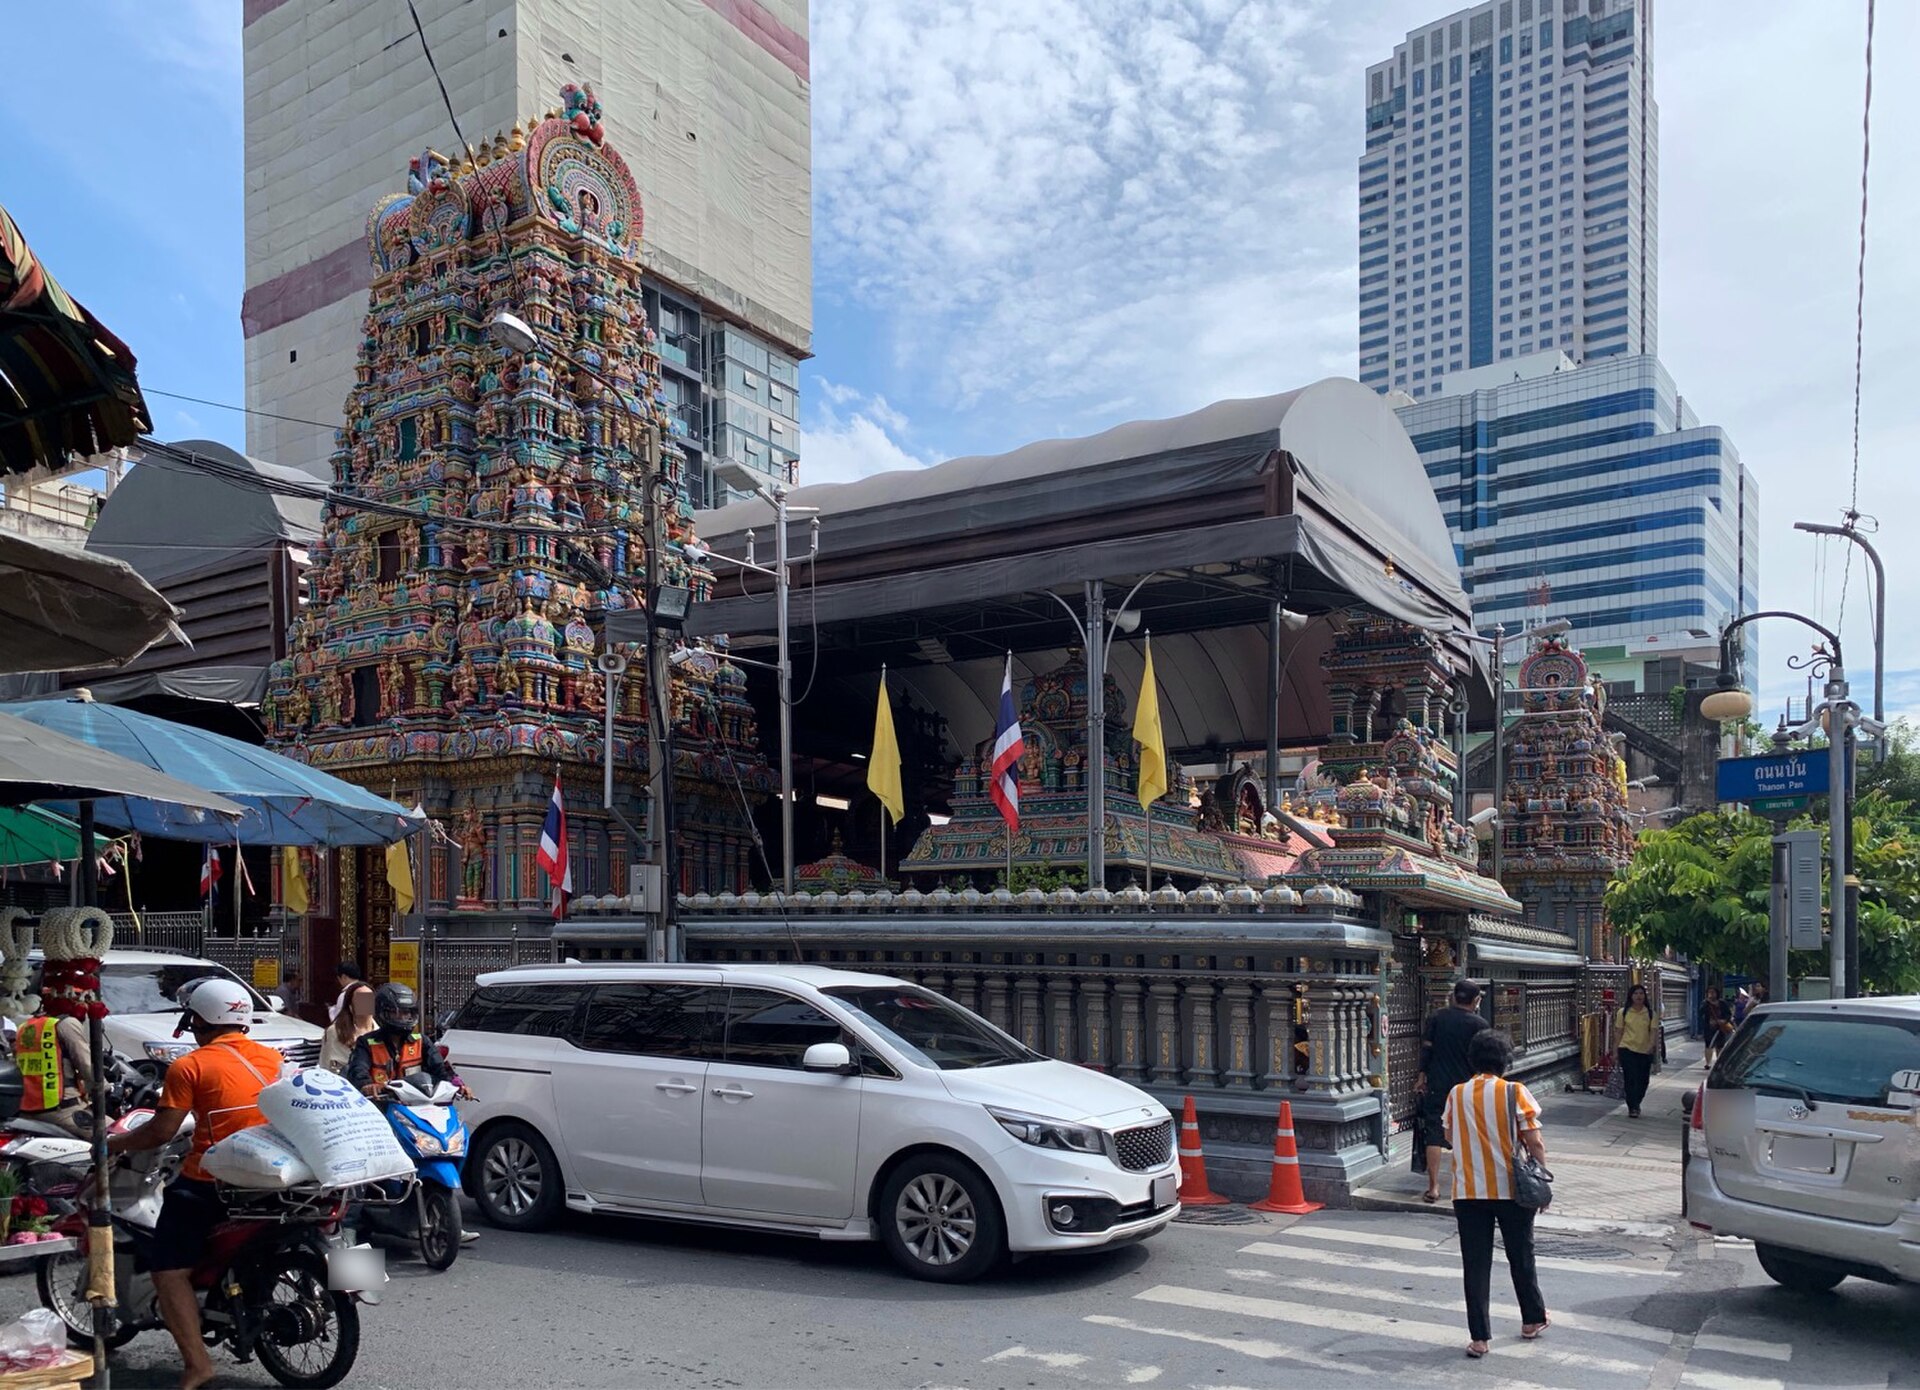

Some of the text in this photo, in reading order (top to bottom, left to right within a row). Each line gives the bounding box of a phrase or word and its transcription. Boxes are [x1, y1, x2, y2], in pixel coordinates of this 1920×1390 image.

[1757, 781, 1804, 792] Thanon Pan
[43, 1032, 56, 1090] POLICE
